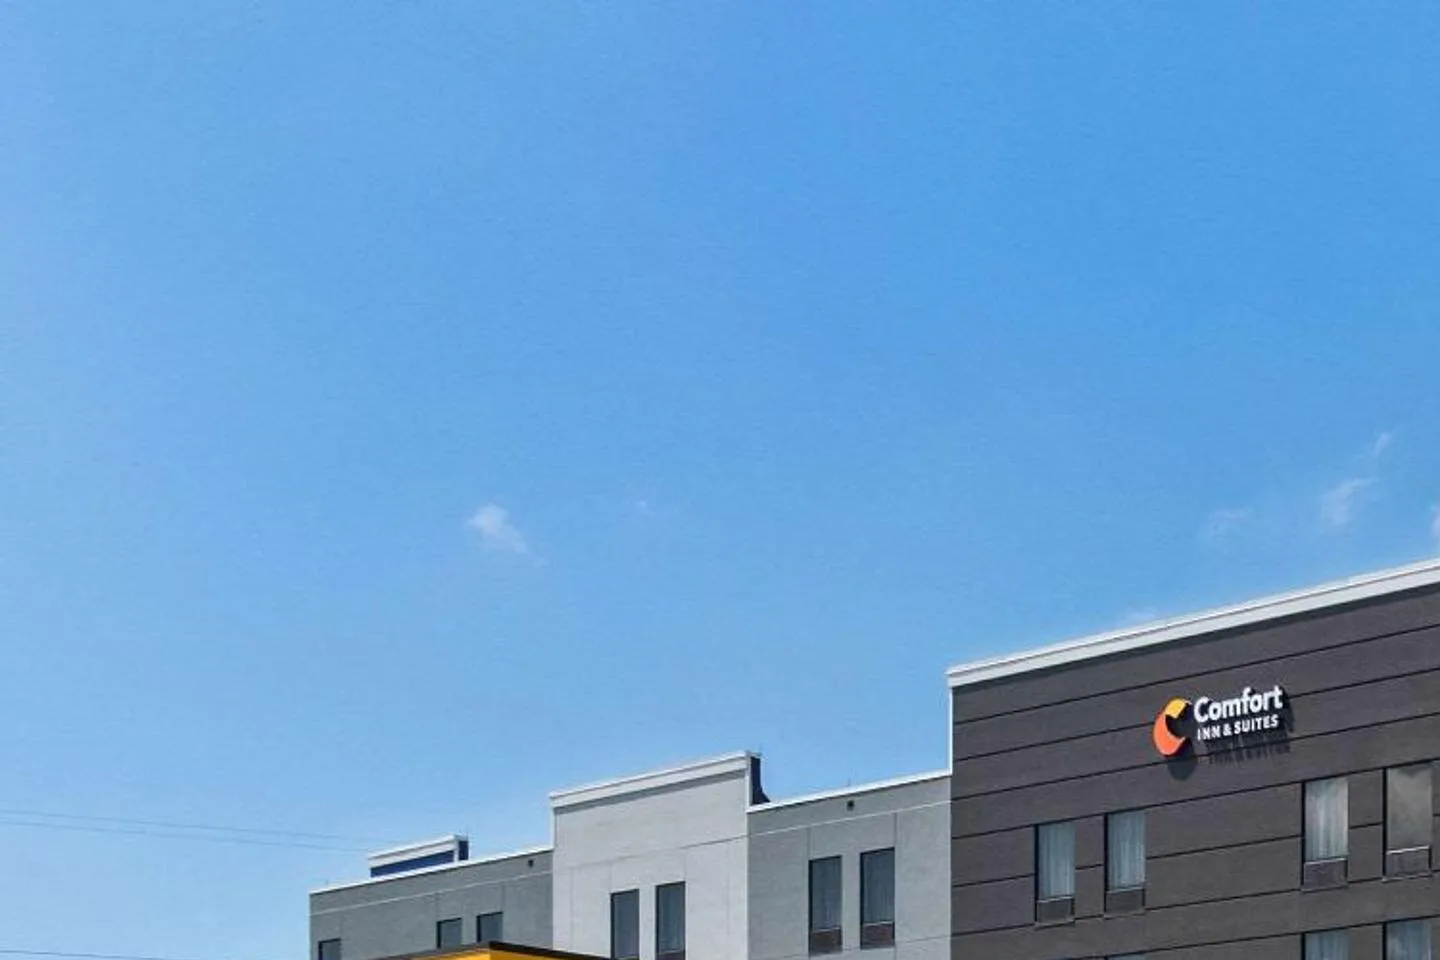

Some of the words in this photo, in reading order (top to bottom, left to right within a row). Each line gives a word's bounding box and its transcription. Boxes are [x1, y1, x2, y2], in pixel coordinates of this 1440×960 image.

[1193, 685, 1283, 722] Comfort
[1197, 725, 1221, 740] INN
[1222, 724, 1232, 737] &
[1233, 714, 1279, 735] SUITES
